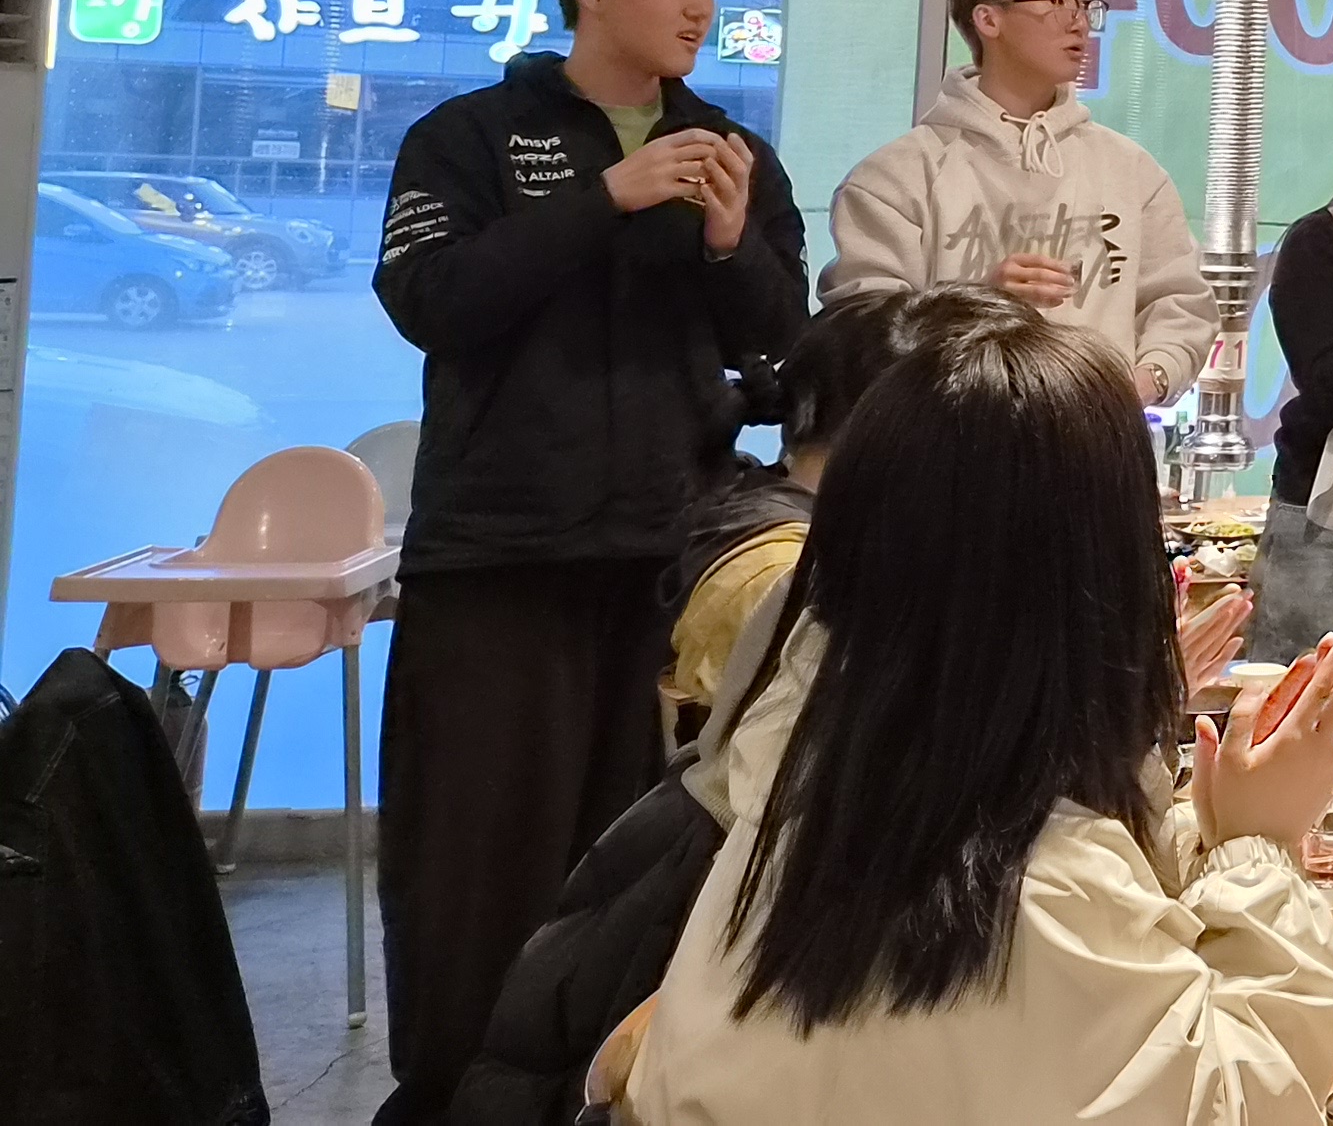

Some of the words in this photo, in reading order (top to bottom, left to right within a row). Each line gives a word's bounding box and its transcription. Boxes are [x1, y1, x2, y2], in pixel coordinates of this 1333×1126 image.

[508, 134, 562, 151] Ansys
[510, 152, 567, 162] MOZA
[528, 168, 575, 182] ALTAIR
